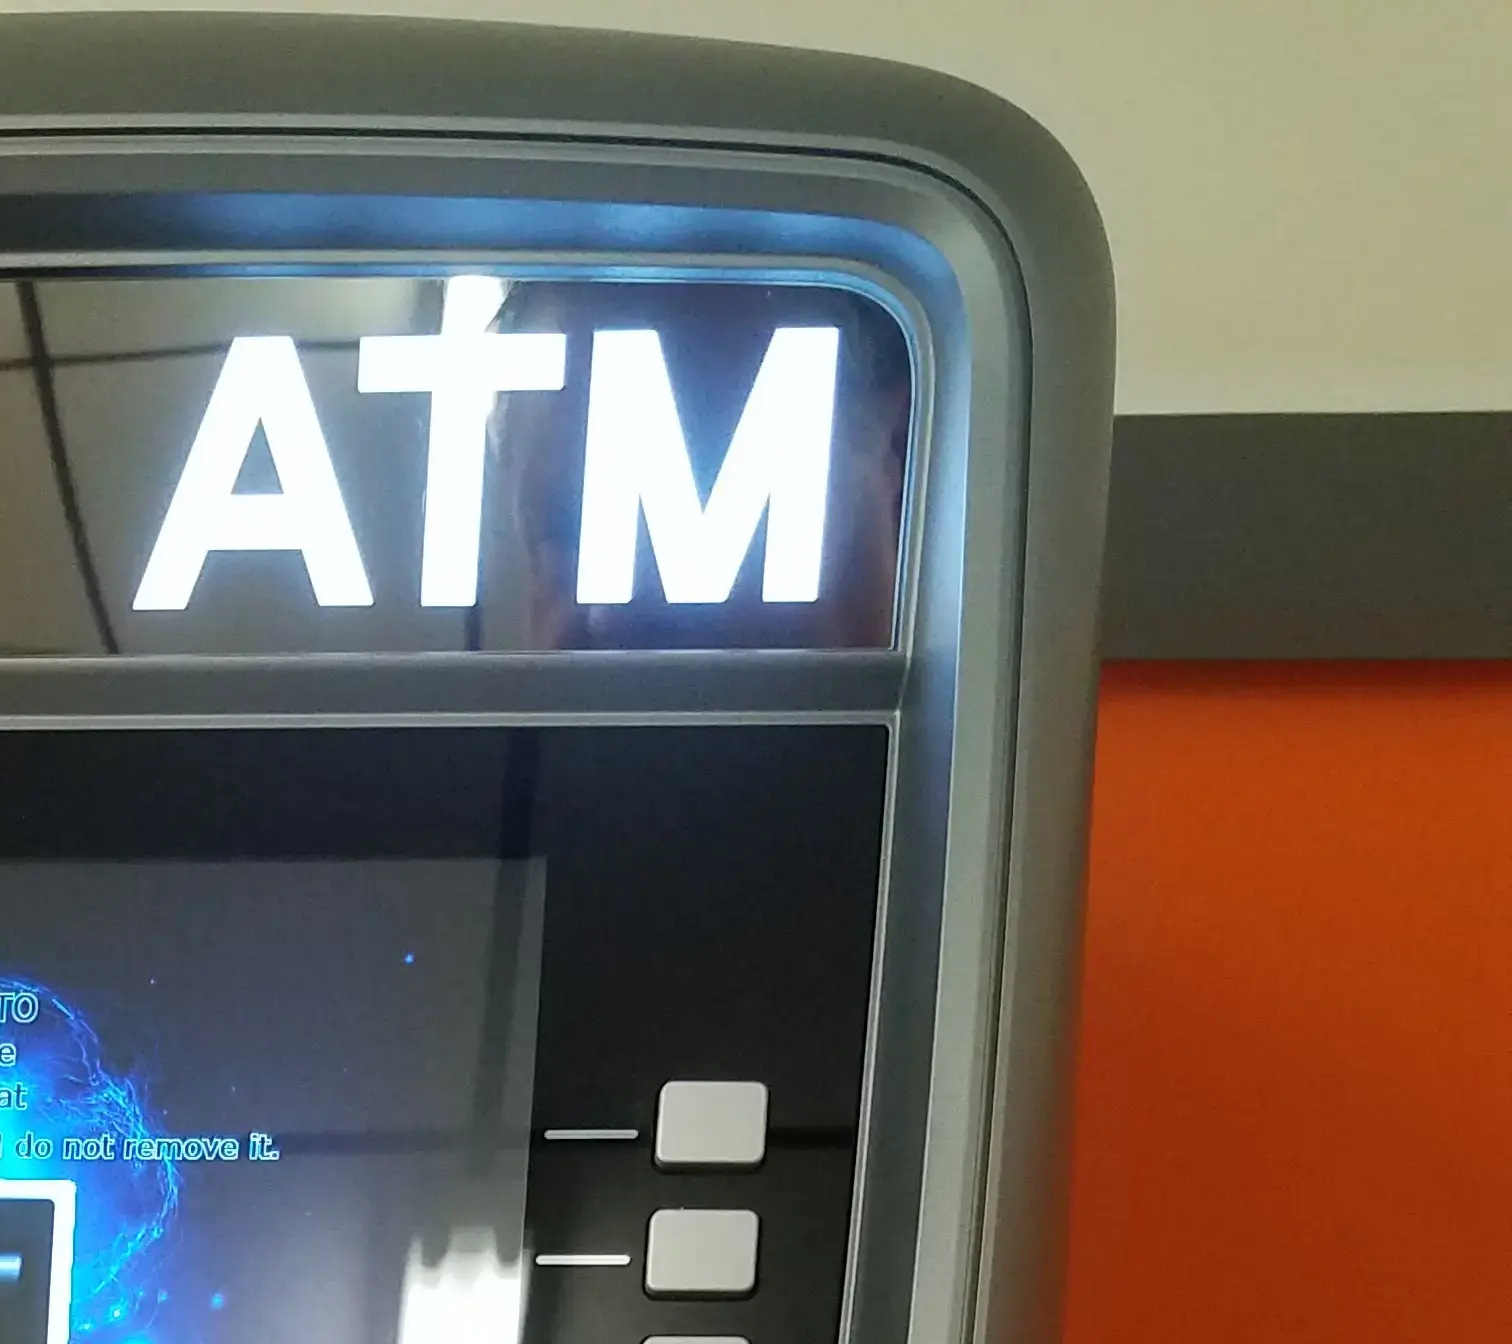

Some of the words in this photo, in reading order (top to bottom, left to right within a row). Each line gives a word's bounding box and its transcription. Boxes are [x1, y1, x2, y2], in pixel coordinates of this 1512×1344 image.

[132, 326, 840, 611] ATM
[15, 1132, 52, 1159] do
[62, 1133, 115, 1160] not
[123, 1136, 239, 1161] remove
[248, 1132, 281, 1161] it.
